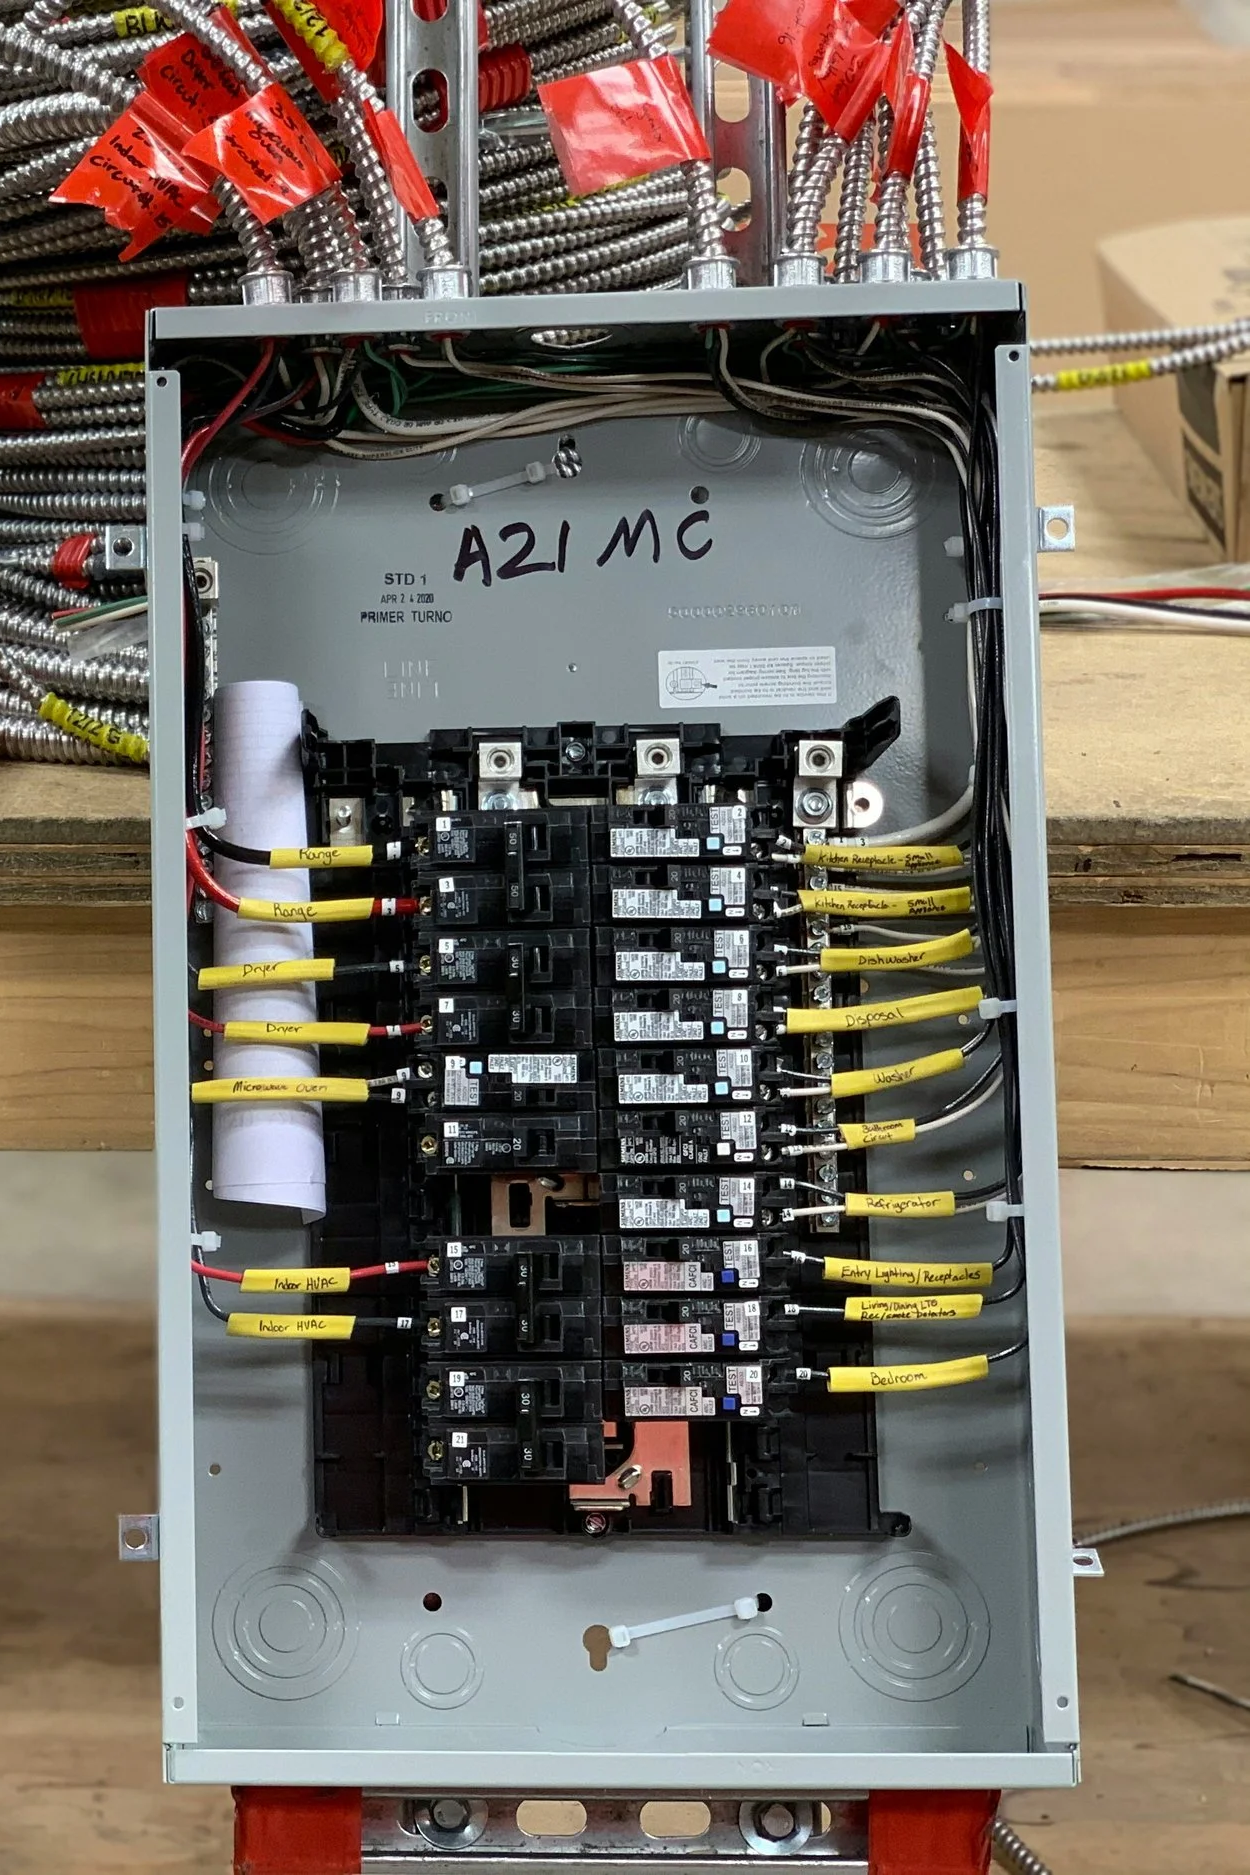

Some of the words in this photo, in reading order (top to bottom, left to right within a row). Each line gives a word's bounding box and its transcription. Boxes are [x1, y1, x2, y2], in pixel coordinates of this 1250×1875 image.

[453, 519, 570, 587] A21
[384, 573, 415, 585] STD
[420, 574, 427, 586] 1
[380, 594, 397, 604] APR
[360, 611, 405, 623] PRIMER
[411, 610, 452, 623] TURNO
[66, 707, 104, 736] 12/2
[107, 727, 121, 744] G
[668, 809, 676, 820] 20
[710, 807, 719, 833] TEST
[509, 833, 517, 845] 50
[299, 849, 341, 866] Range
[670, 871, 678, 882] 20
[711, 869, 719, 894] TEST
[511, 885, 519, 897] 50
[815, 899, 845, 911] Kitchen
[273, 902, 317, 922] Range
[674, 932, 682, 943] 20
[715, 932, 723, 957] TEST
[858, 952, 926, 966] Dishwasher
[243, 961, 285, 977] Dryer
[673, 994, 681, 1005] 20
[714, 991, 723, 1016] TEST
[845, 1008, 904, 1028] Disposal
[266, 1023, 303, 1039] Dryer
[676, 1055, 684, 1066] 20
[718, 1050, 727, 1076] TEST
[873, 1066, 915, 1084] Washer
[296, 1082, 328, 1093] Oven
[469, 1081, 478, 1104] TEST
[513, 1091, 522, 1102] 20
[679, 1115, 686, 1126] 20
[721, 1114, 730, 1139] TEST
[448, 1125, 456, 1134] 11
[512, 1138, 521, 1150] 20
[679, 1182, 686, 1193] 20
[721, 1178, 729, 1203] TEST
[783, 1180, 792, 1188] 14
[866, 1196, 941, 1214] Refrigerator
[450, 1246, 458, 1254] 15
[682, 1243, 689, 1254] 20
[724, 1242, 733, 1268] TEST
[688, 1264, 697, 1289] CAFCI
[841, 1265, 871, 1278] Entry
[274, 1278, 301, 1290] Indoor
[306, 1276, 338, 1290] HVAC
[455, 1310, 463, 1319] 17
[682, 1306, 689, 1317] 20
[725, 1304, 734, 1329] TEST
[259, 1320, 290, 1333] Indoor
[297, 1320, 327, 1330] HVAC
[689, 1325, 698, 1350] CAFCI
[453, 1374, 461, 1383] 19
[684, 1370, 691, 1381] 20
[728, 1367, 737, 1393] TEST
[799, 1369, 808, 1378] 20
[870, 1371, 928, 1387] Bedroom
[521, 1393, 530, 1405] 30
[690, 1389, 698, 1414] CAFCI
[456, 1435, 464, 1444] 21
[523, 1448, 532, 1461] 30
